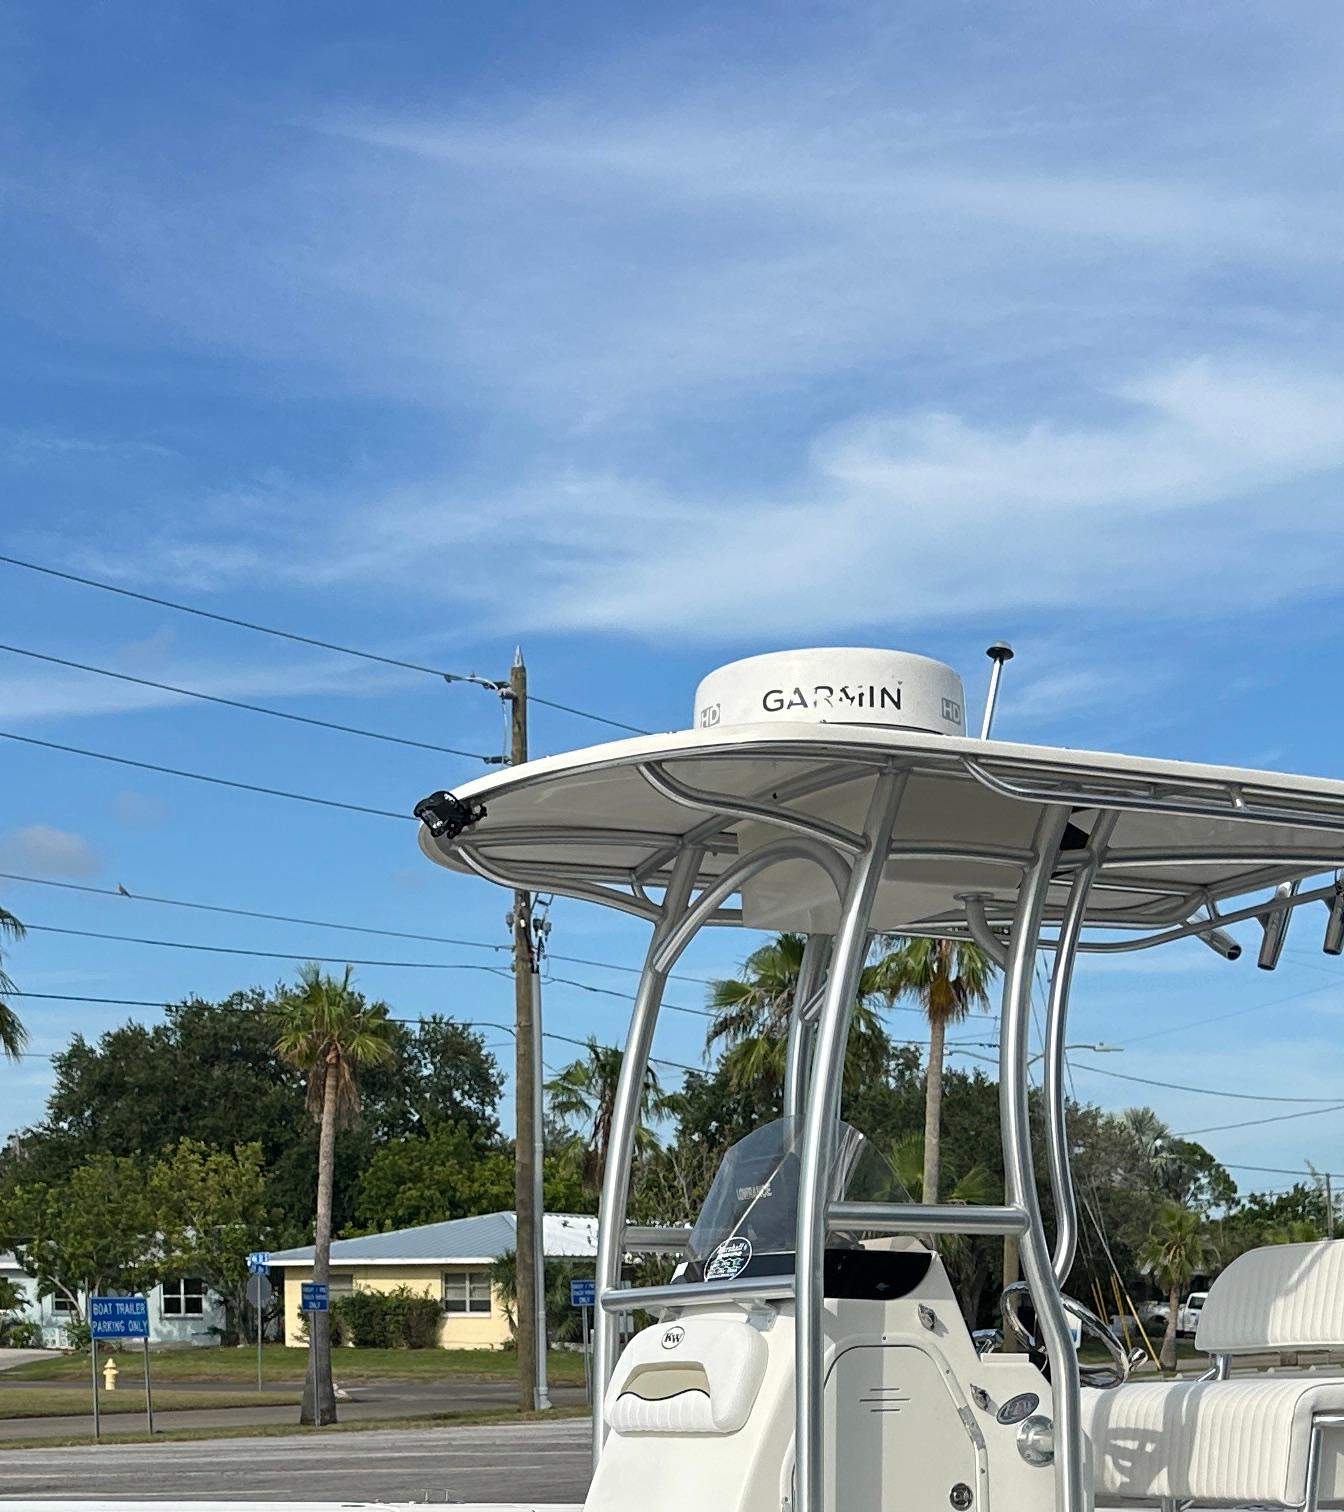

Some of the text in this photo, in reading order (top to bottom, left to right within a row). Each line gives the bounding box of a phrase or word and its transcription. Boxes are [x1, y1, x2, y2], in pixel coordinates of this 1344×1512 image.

[762, 683, 902, 713] GARMIN
[700, 704, 720, 728] HD
[942, 701, 961, 724] HD
[92, 1302, 146, 1316] BOAT TRAILER
[92, 1320, 148, 1333] PARKING ONLY
